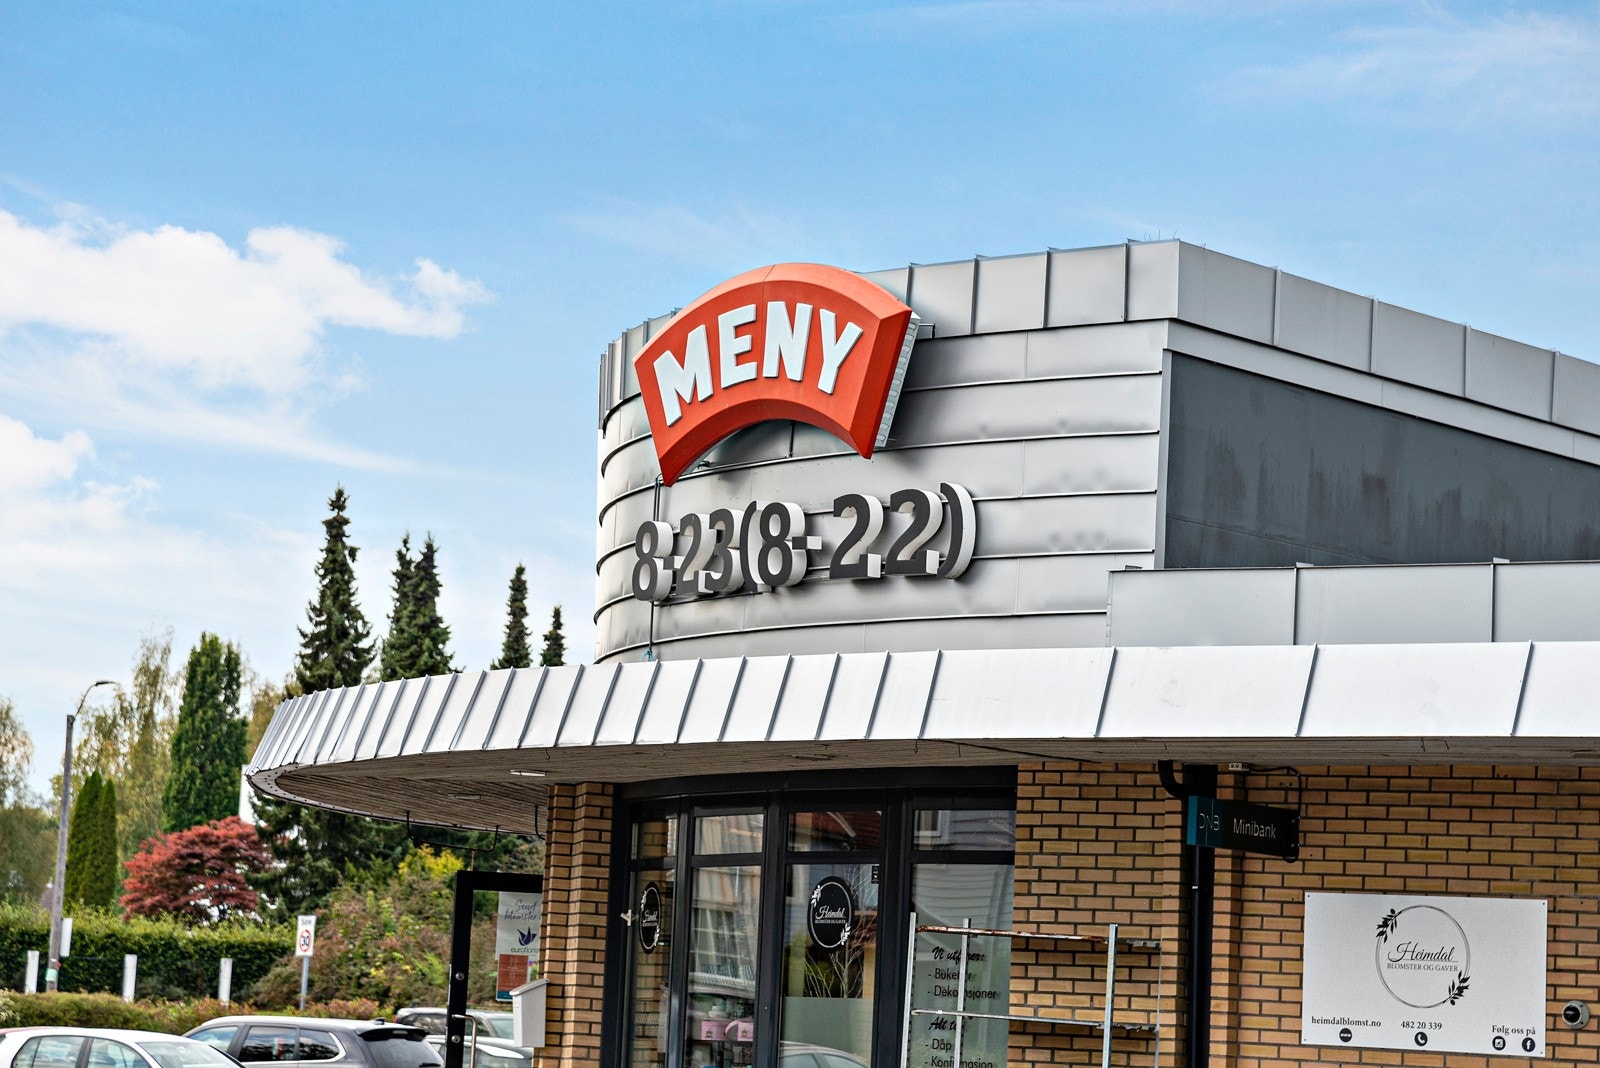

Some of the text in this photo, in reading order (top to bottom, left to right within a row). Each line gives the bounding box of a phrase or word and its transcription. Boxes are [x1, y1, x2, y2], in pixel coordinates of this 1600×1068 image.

[653, 301, 864, 428] MENY
[1233, 818, 1277, 839] Minibank
[932, 946, 985, 966] Vi utfrer:
[1387, 941, 1456, 963] Heimdal
[935, 967, 973, 980] Buketr
[1387, 963, 1422, 971] BLOMSTER
[934, 985, 997, 1000] Dekosjoner
[928, 1016, 948, 1030] Alt
[1311, 1016, 1382, 1027] heimdalblomst.no
[1401, 1021, 1443, 1030] 482 20 339
[1492, 1025, 1510, 1036] Følg
[1526, 1027, 1536, 1036] på
[932, 1038, 952, 1053] Dåp
[931, 1055, 993, 1068] Konfimasjon
